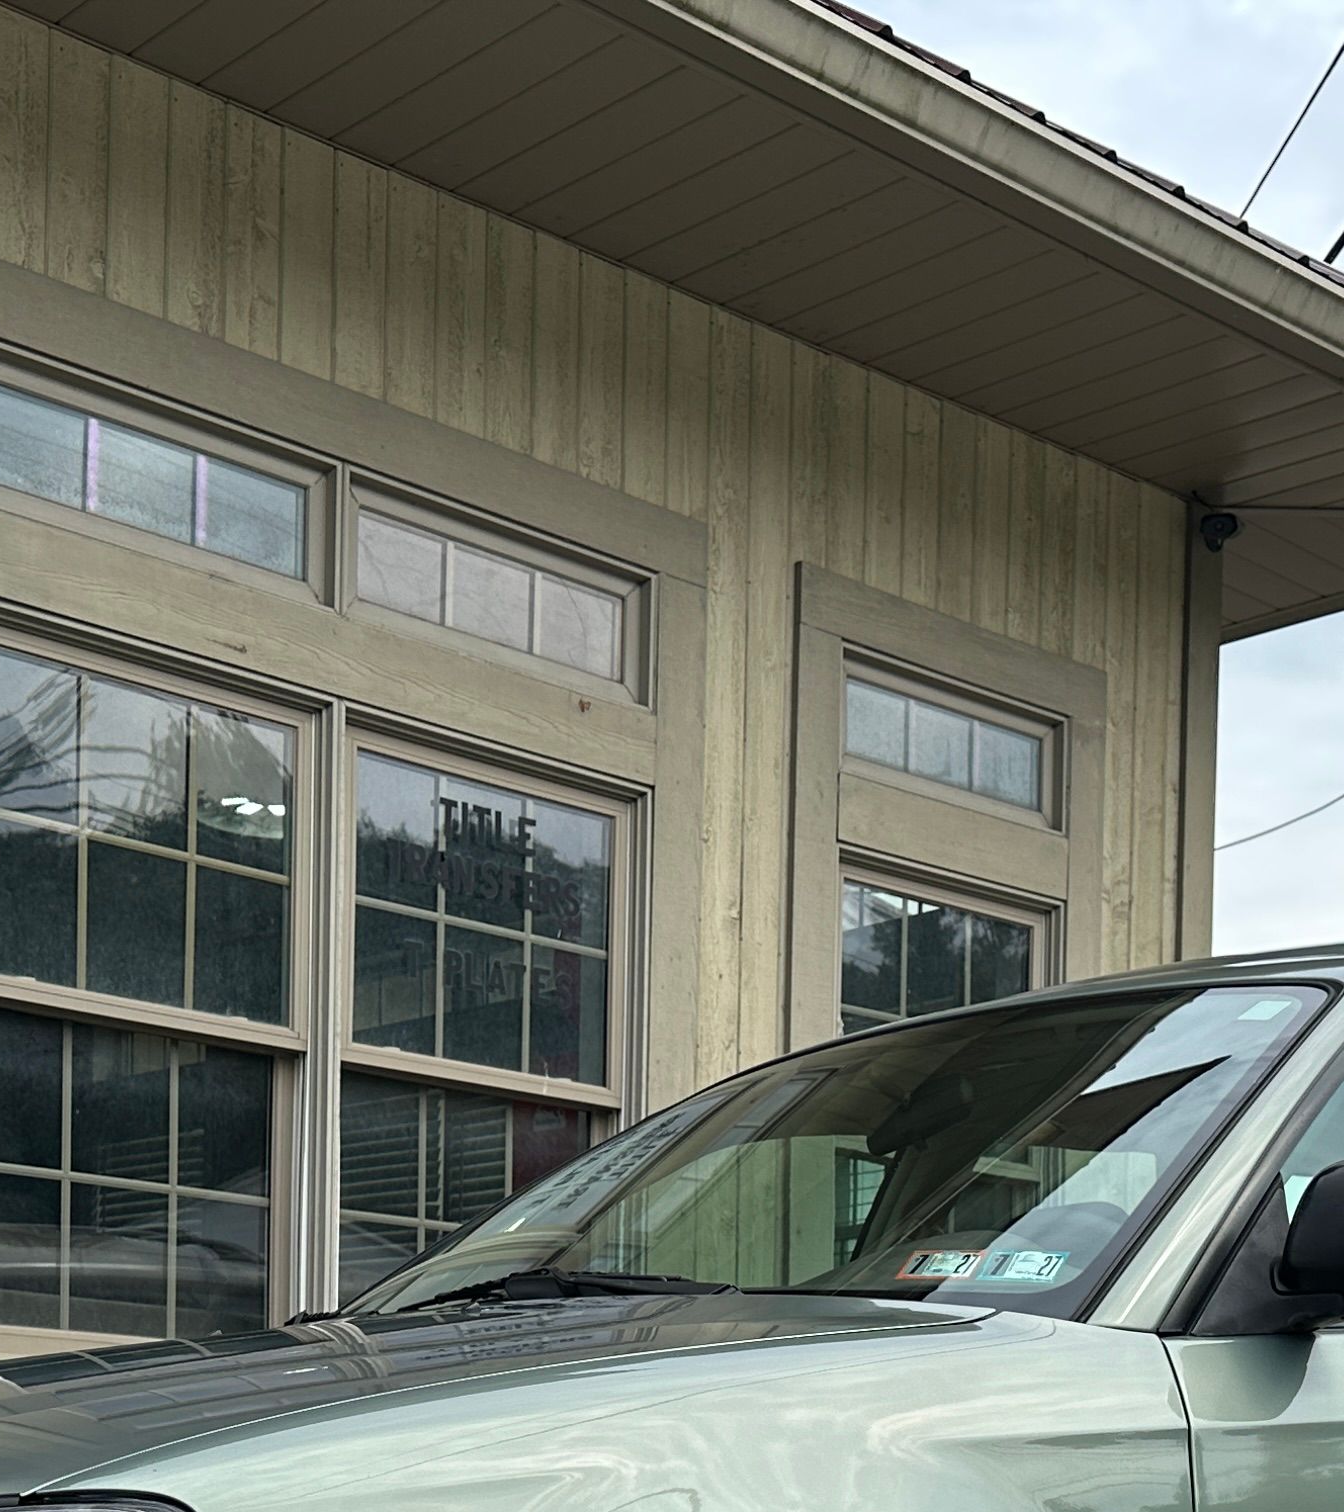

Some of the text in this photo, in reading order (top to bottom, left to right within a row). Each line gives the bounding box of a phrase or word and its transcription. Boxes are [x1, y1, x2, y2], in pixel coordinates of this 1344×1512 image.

[439, 798, 536, 857] TITLE
[953, 1254, 979, 1275] 27
[1035, 1255, 1060, 1277] 27
